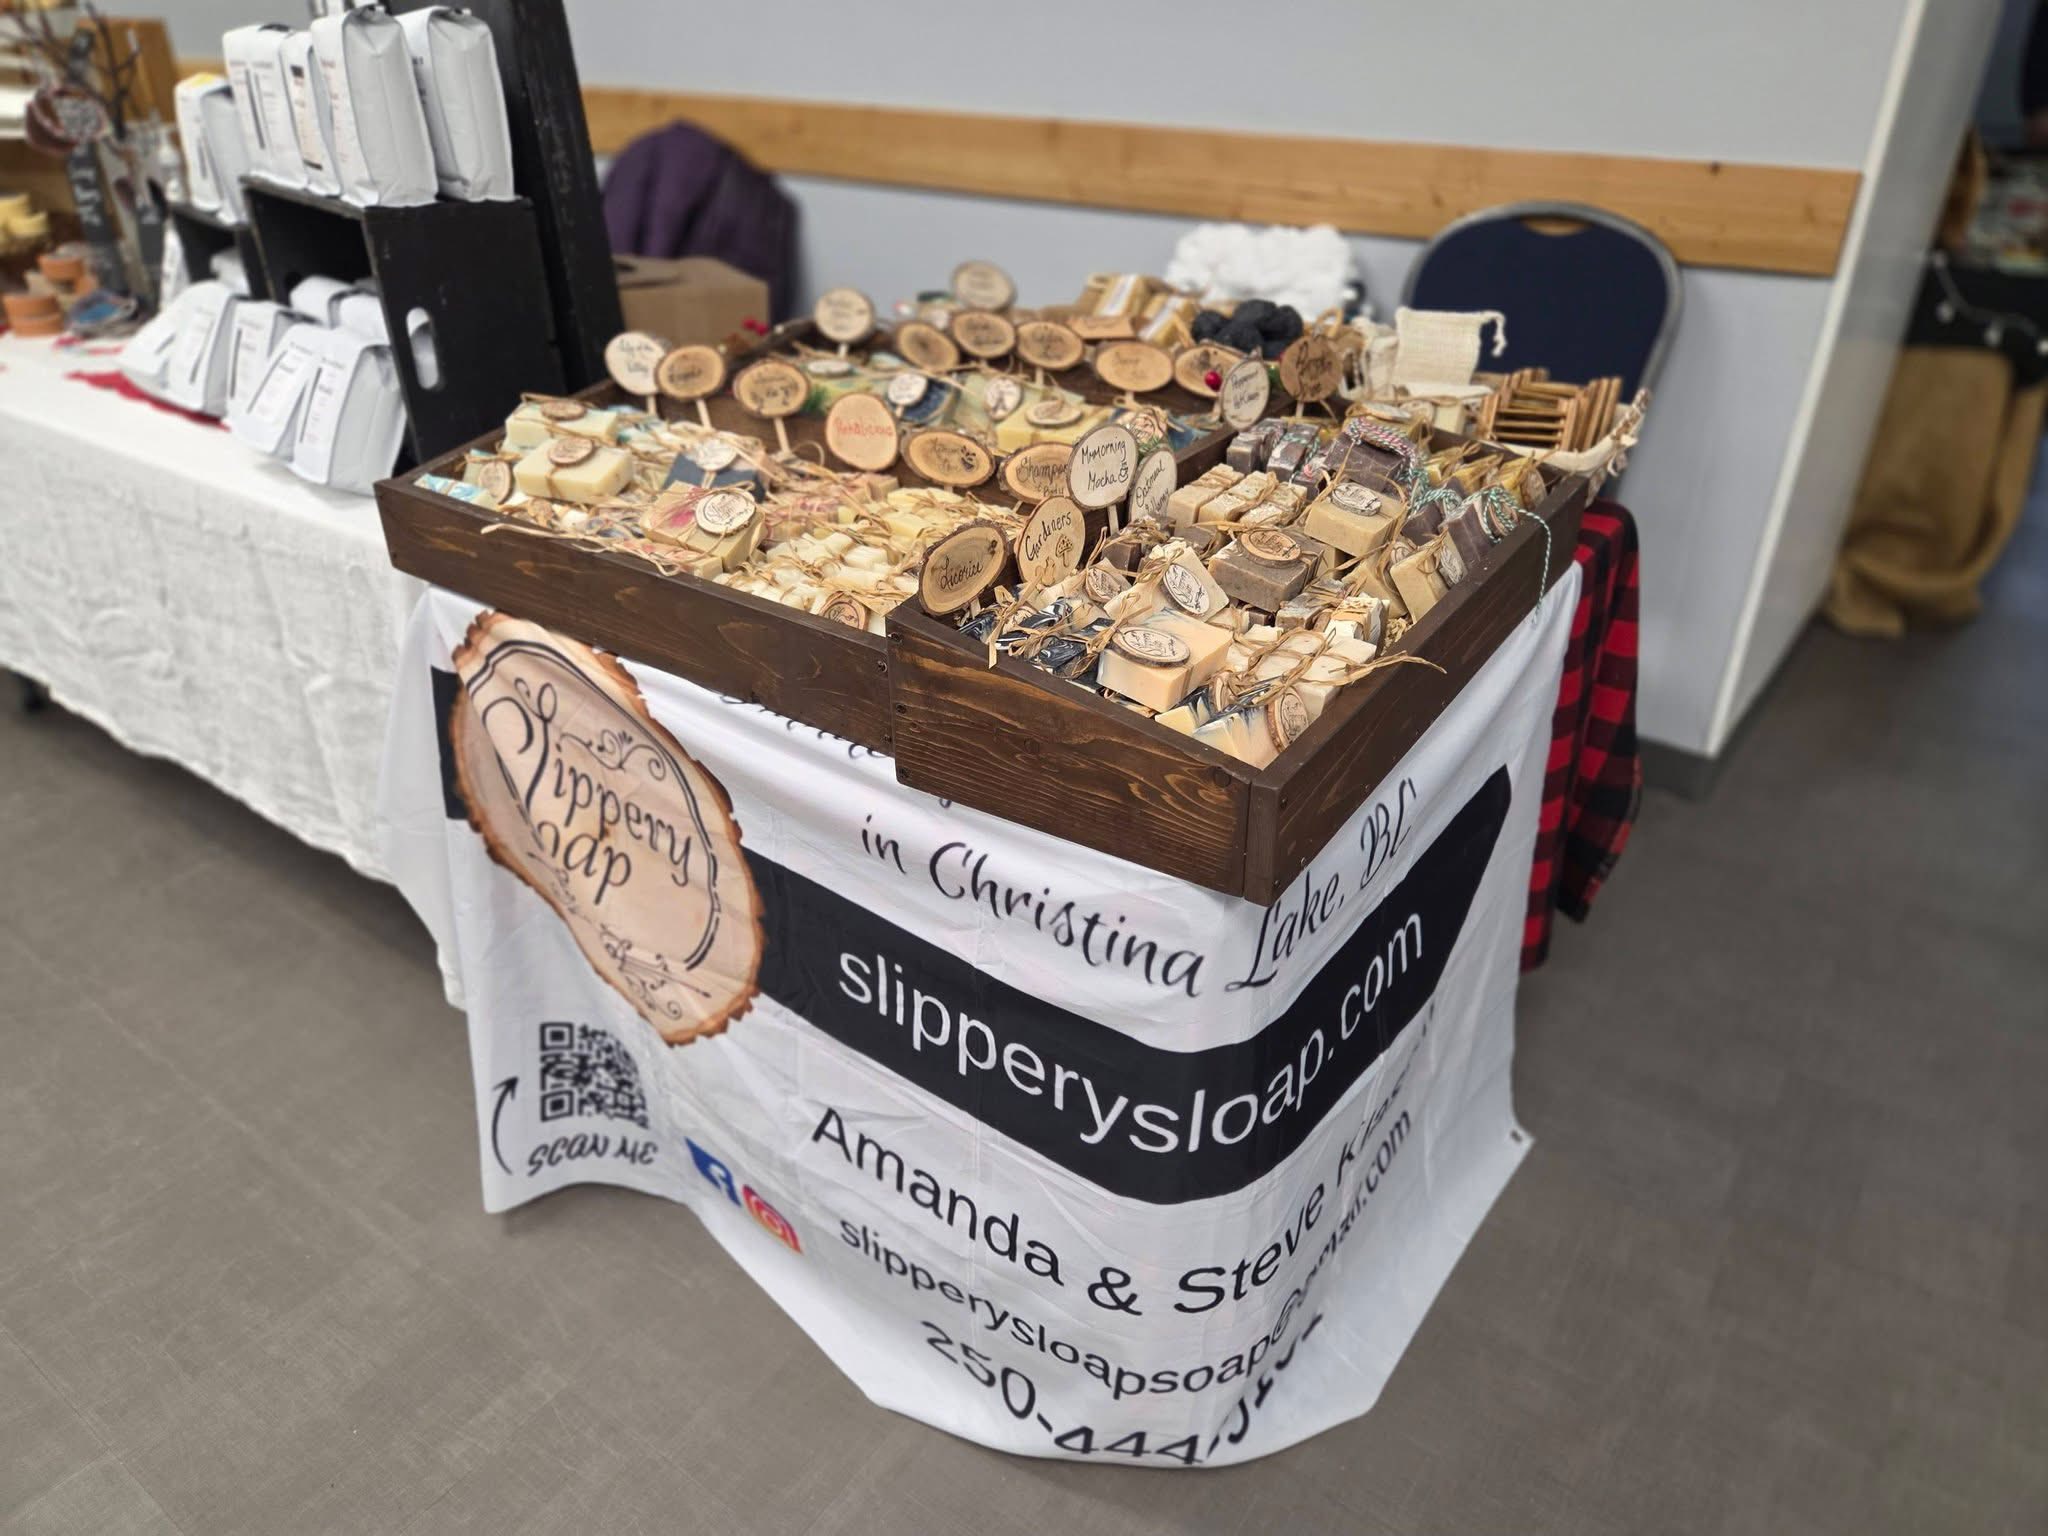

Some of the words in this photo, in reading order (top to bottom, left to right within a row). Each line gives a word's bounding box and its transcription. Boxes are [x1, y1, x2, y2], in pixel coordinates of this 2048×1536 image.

[1025, 511, 1072, 562] Gardeners
[1087, 469, 1118, 491] Mocha
[861, 814, 907, 874] in
[928, 841, 1205, 998] Christina
[1224, 869, 1346, 993] Lake,
[1360, 777, 1417, 891] BC
[838, 911, 1423, 1154] slipperysloap.com
[526, 1133, 610, 1178] SCAN
[614, 1136, 659, 1166] ME
[812, 1106, 1065, 1287] Amanda
[1087, 1267, 1143, 1317] &
[1173, 1182, 1326, 1314] Steve
